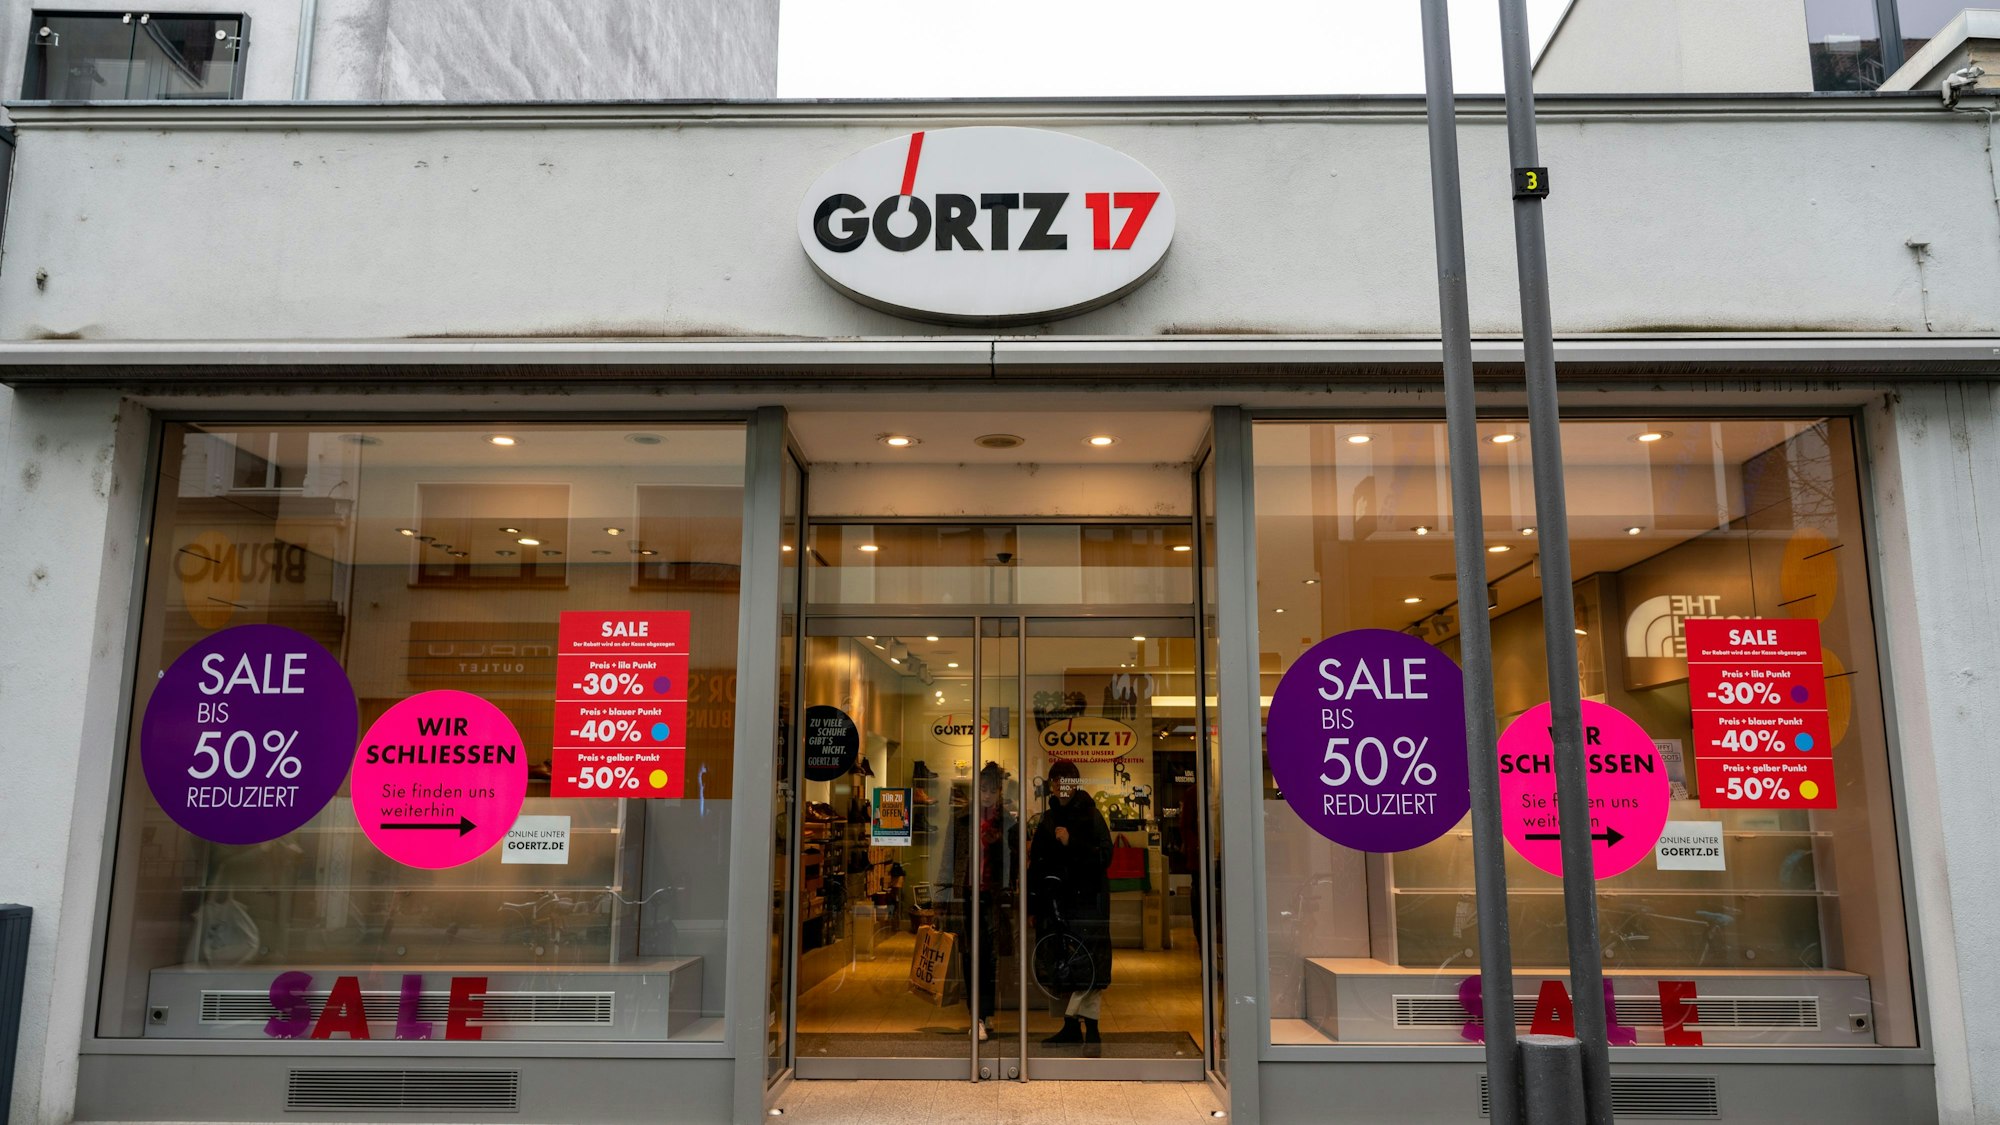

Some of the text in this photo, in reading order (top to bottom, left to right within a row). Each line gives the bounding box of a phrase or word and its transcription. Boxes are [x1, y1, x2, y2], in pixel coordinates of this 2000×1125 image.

[1526, 171, 1538, 190] 3
[1085, 192, 1160, 250] 17
[601, 621, 649, 637] SALE
[1729, 629, 1778, 646] SALE
[590, 661, 610, 669] Preis
[618, 661, 631, 669] lila
[633, 661, 657, 669] Punkt
[198, 652, 307, 695] SALE
[1318, 657, 1428, 701] SALE
[1722, 670, 1743, 678] Preis
[1751, 670, 1764, 678] lila
[1766, 670, 1791, 678] Punkt
[572, 673, 644, 695] -30%
[1707, 681, 1781, 704] -30%
[197, 702, 229, 723] BIS
[580, 708, 601, 716] Preis
[609, 708, 636, 716] blauer
[638, 708, 662, 716] Punkt
[1322, 708, 1354, 729] BIS
[417, 717, 468, 736] WIR
[810, 718, 843, 727] ZU VIELE
[1719, 717, 1740, 725] Preis
[1748, 717, 1776, 725] blauer
[1778, 717, 1803, 725] Punkt
[570, 719, 642, 742] -40%
[817, 728, 847, 737] SCHUHE
[1114, 731, 1132, 746] 17
[1711, 729, 1786, 752] -40%
[187, 730, 302, 779] 50%
[366, 745, 516, 765] SCHLIESSEN
[822, 745, 847, 755] NICHT.
[578, 754, 599, 762] Preis
[606, 754, 634, 763] gelber
[636, 754, 660, 762] Punkt
[1319, 736, 1437, 786] 50%
[1500, 754, 1654, 774] SCHSSEN
[1723, 764, 1744, 772] Preis
[1753, 764, 1780, 773] gelber
[1782, 764, 1807, 772] Punkt
[568, 766, 640, 789] -50%
[382, 784, 495, 798] Sie finden uns
[1716, 777, 1790, 800] -50%
[187, 786, 299, 808] REDUZIERT
[894, 793, 903, 802] ZU
[1324, 793, 1437, 815] REDUZIERT
[1522, 793, 1639, 808] Sie fen uns
[381, 803, 455, 817] weiterhin
[882, 808, 902, 818] OFFEN
[1523, 814, 1599, 827] weitn
[508, 830, 538, 838] ONLINE
[1693, 836, 1719, 844] UNTER
[508, 841, 564, 850] GOERTZ.DE
[1661, 848, 1720, 857] GOERTZ.DE
[263, 971, 488, 1040] SALE
